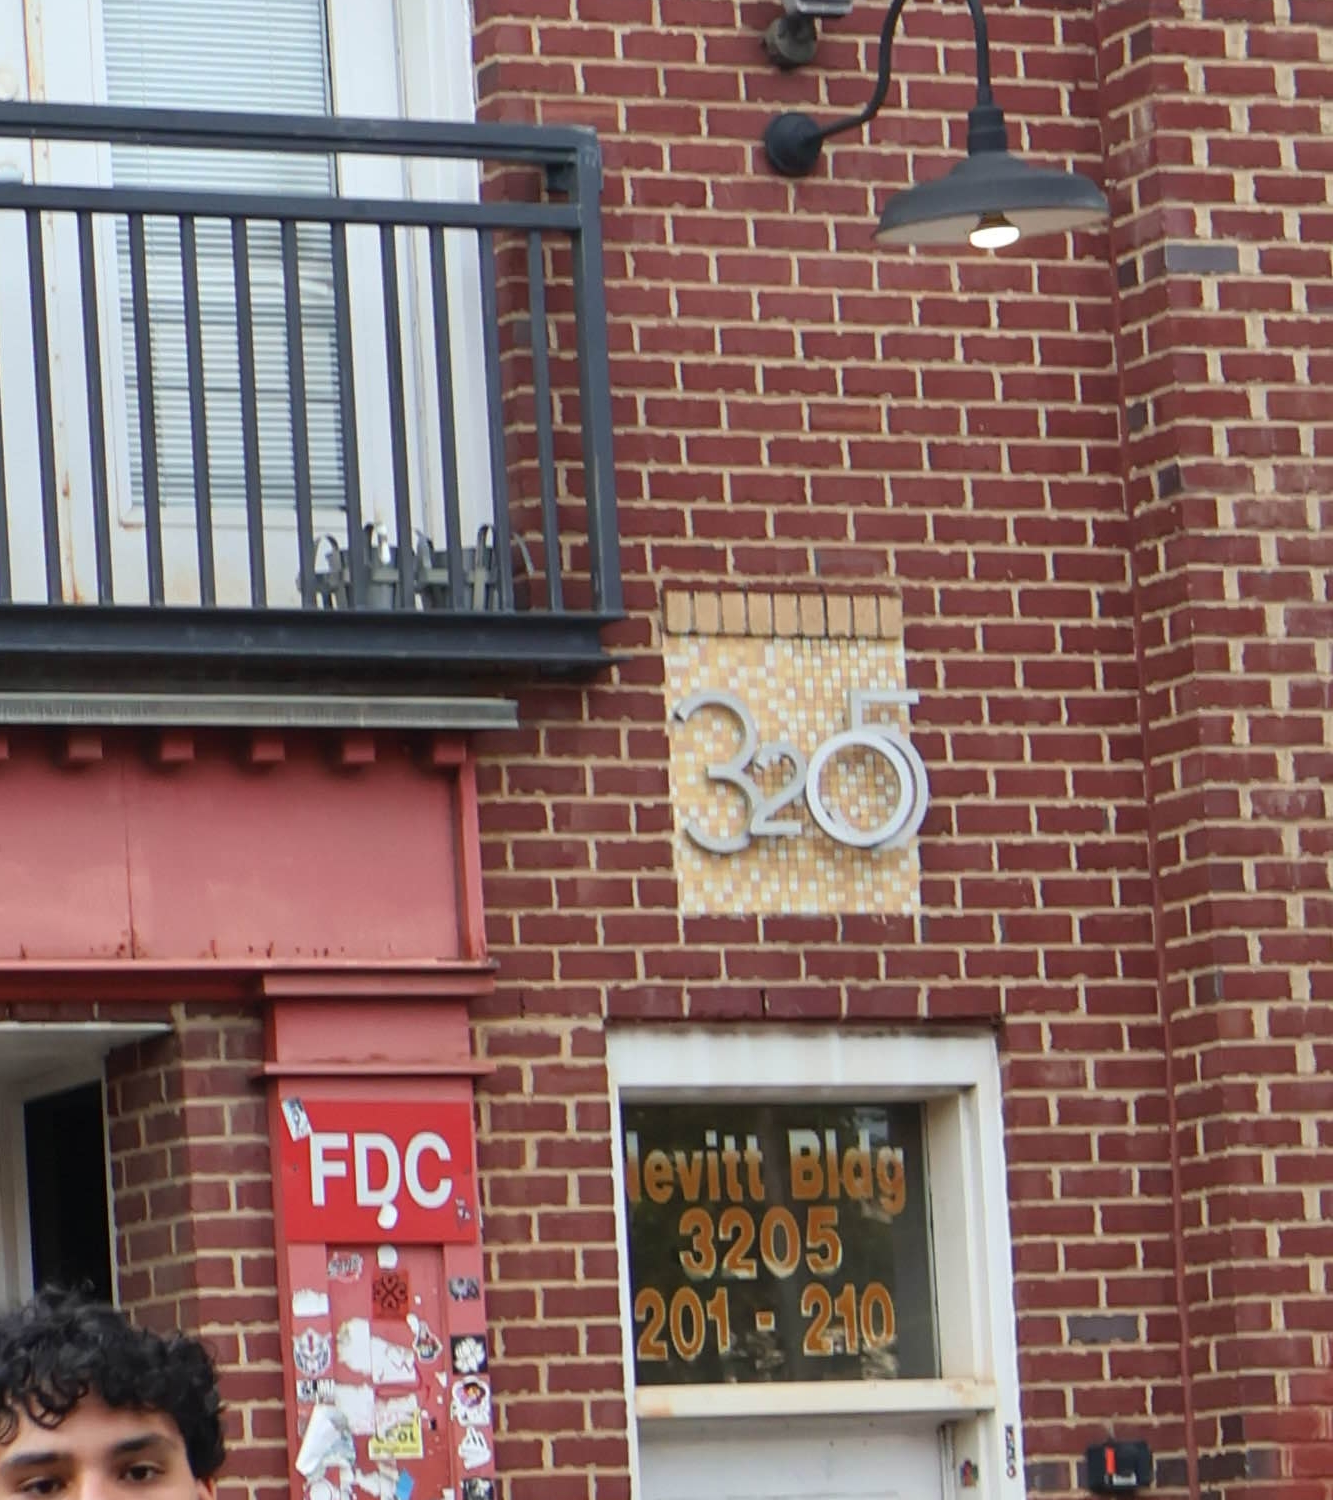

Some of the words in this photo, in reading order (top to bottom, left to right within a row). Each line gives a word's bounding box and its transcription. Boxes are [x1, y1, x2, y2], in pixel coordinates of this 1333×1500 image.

[309, 1131, 454, 1209] FDC
[788, 1128, 906, 1216] Bldg
[678, 1205, 843, 1280] 3205
[634, 1286, 732, 1362] 201
[800, 1281, 896, 1357] 210
